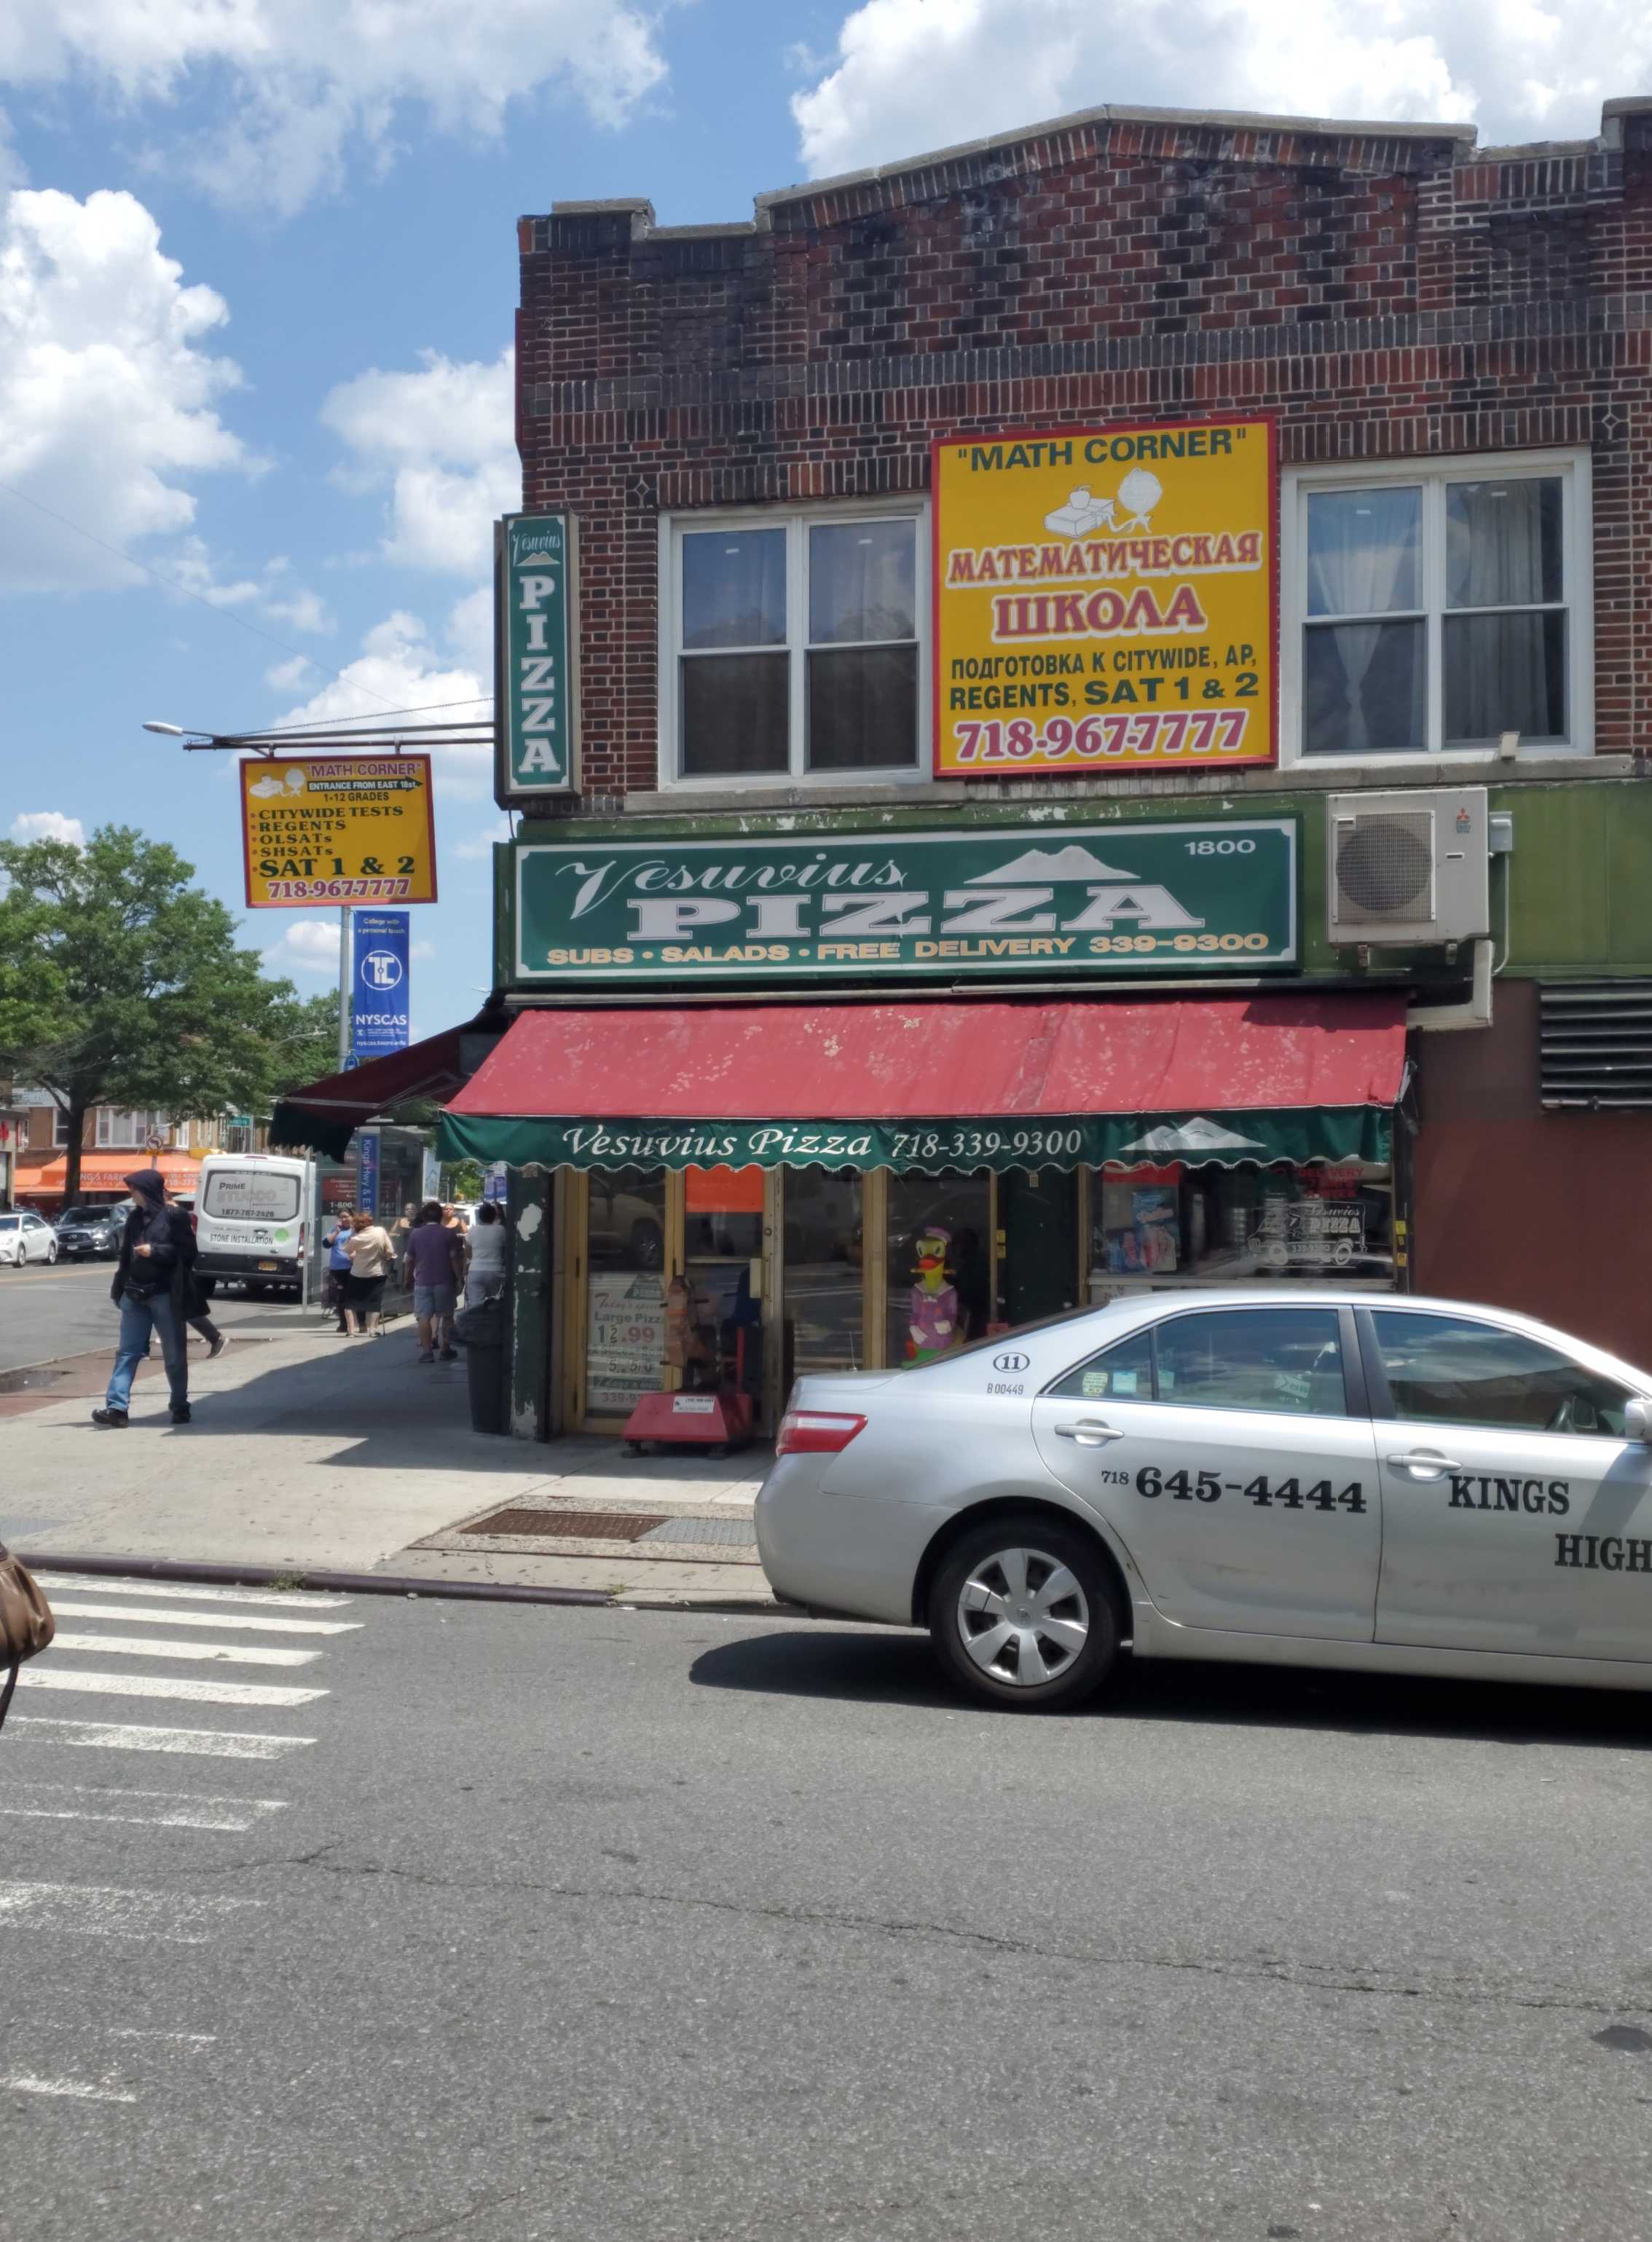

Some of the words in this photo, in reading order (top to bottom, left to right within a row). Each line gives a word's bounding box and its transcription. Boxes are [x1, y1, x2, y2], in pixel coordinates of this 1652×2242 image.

[947, 532, 1262, 585] МАТЕМАТИЧЕСКАЯ
[993, 585, 1206, 641] ШКОЛА
[518, 575, 561, 774] PIZZA
[951, 653, 1085, 680] ПОДГОТОВКА
[950, 682, 1077, 711] REGENTS,
[1084, 677, 1165, 706] SAT
[1173, 676, 1189, 700] 1
[1202, 679, 1226, 699] &
[1235, 672, 1259, 697] 2
[955, 709, 1248, 760] 718-967-7777
[309, 781, 353, 791] ENTRANCE
[353, 781, 376, 790] FROM
[377, 781, 398, 789] EAST
[323, 792, 346, 802] 1-12
[348, 791, 390, 801] GRADES
[259, 807, 346, 820] CITYWIDE
[349, 806, 404, 817] TESTS
[259, 820, 346, 832] REGENTS
[259, 833, 332, 845] OLSATs
[260, 846, 334, 857] SHSATs
[259, 858, 318, 878] SAT
[331, 857, 345, 876] 1
[361, 857, 385, 875] &
[398, 856, 415, 874] 2
[554, 853, 908, 920] Vesuvius
[1184, 839, 1256, 856] 1800
[267, 878, 411, 899] 718-967-7777
[626, 885, 1205, 941] PIZZA
[547, 947, 634, 965] SUBS
[661, 943, 790, 964] SALADS
[817, 942, 901, 960] FREE
[915, 937, 1077, 958] DELIVERY
[1089, 933, 1269, 954] 339-9300
[355, 1014, 407, 1025] NYSCAS
[361, 1139, 372, 1165] Kings
[563, 1124, 738, 1156] Vesuvius
[748, 1127, 872, 1156] Pizza
[891, 1129, 1082, 1158] 718-339-9300
[361, 1166, 371, 1187] Hwy
[210, 1233, 229, 1243] STONE
[230, 1234, 273, 1245] INSTALLATION
[594, 1311, 632, 1325] Large
[634, 1313, 664, 1324] Pizz
[1002, 1356, 1020, 1369] 11
[1101, 1470, 1129, 1485] 718
[1136, 1466, 1367, 1514] 645-4444
[1448, 1474, 1570, 1516] KINGS
[1554, 1533, 1652, 1573] HIGH
